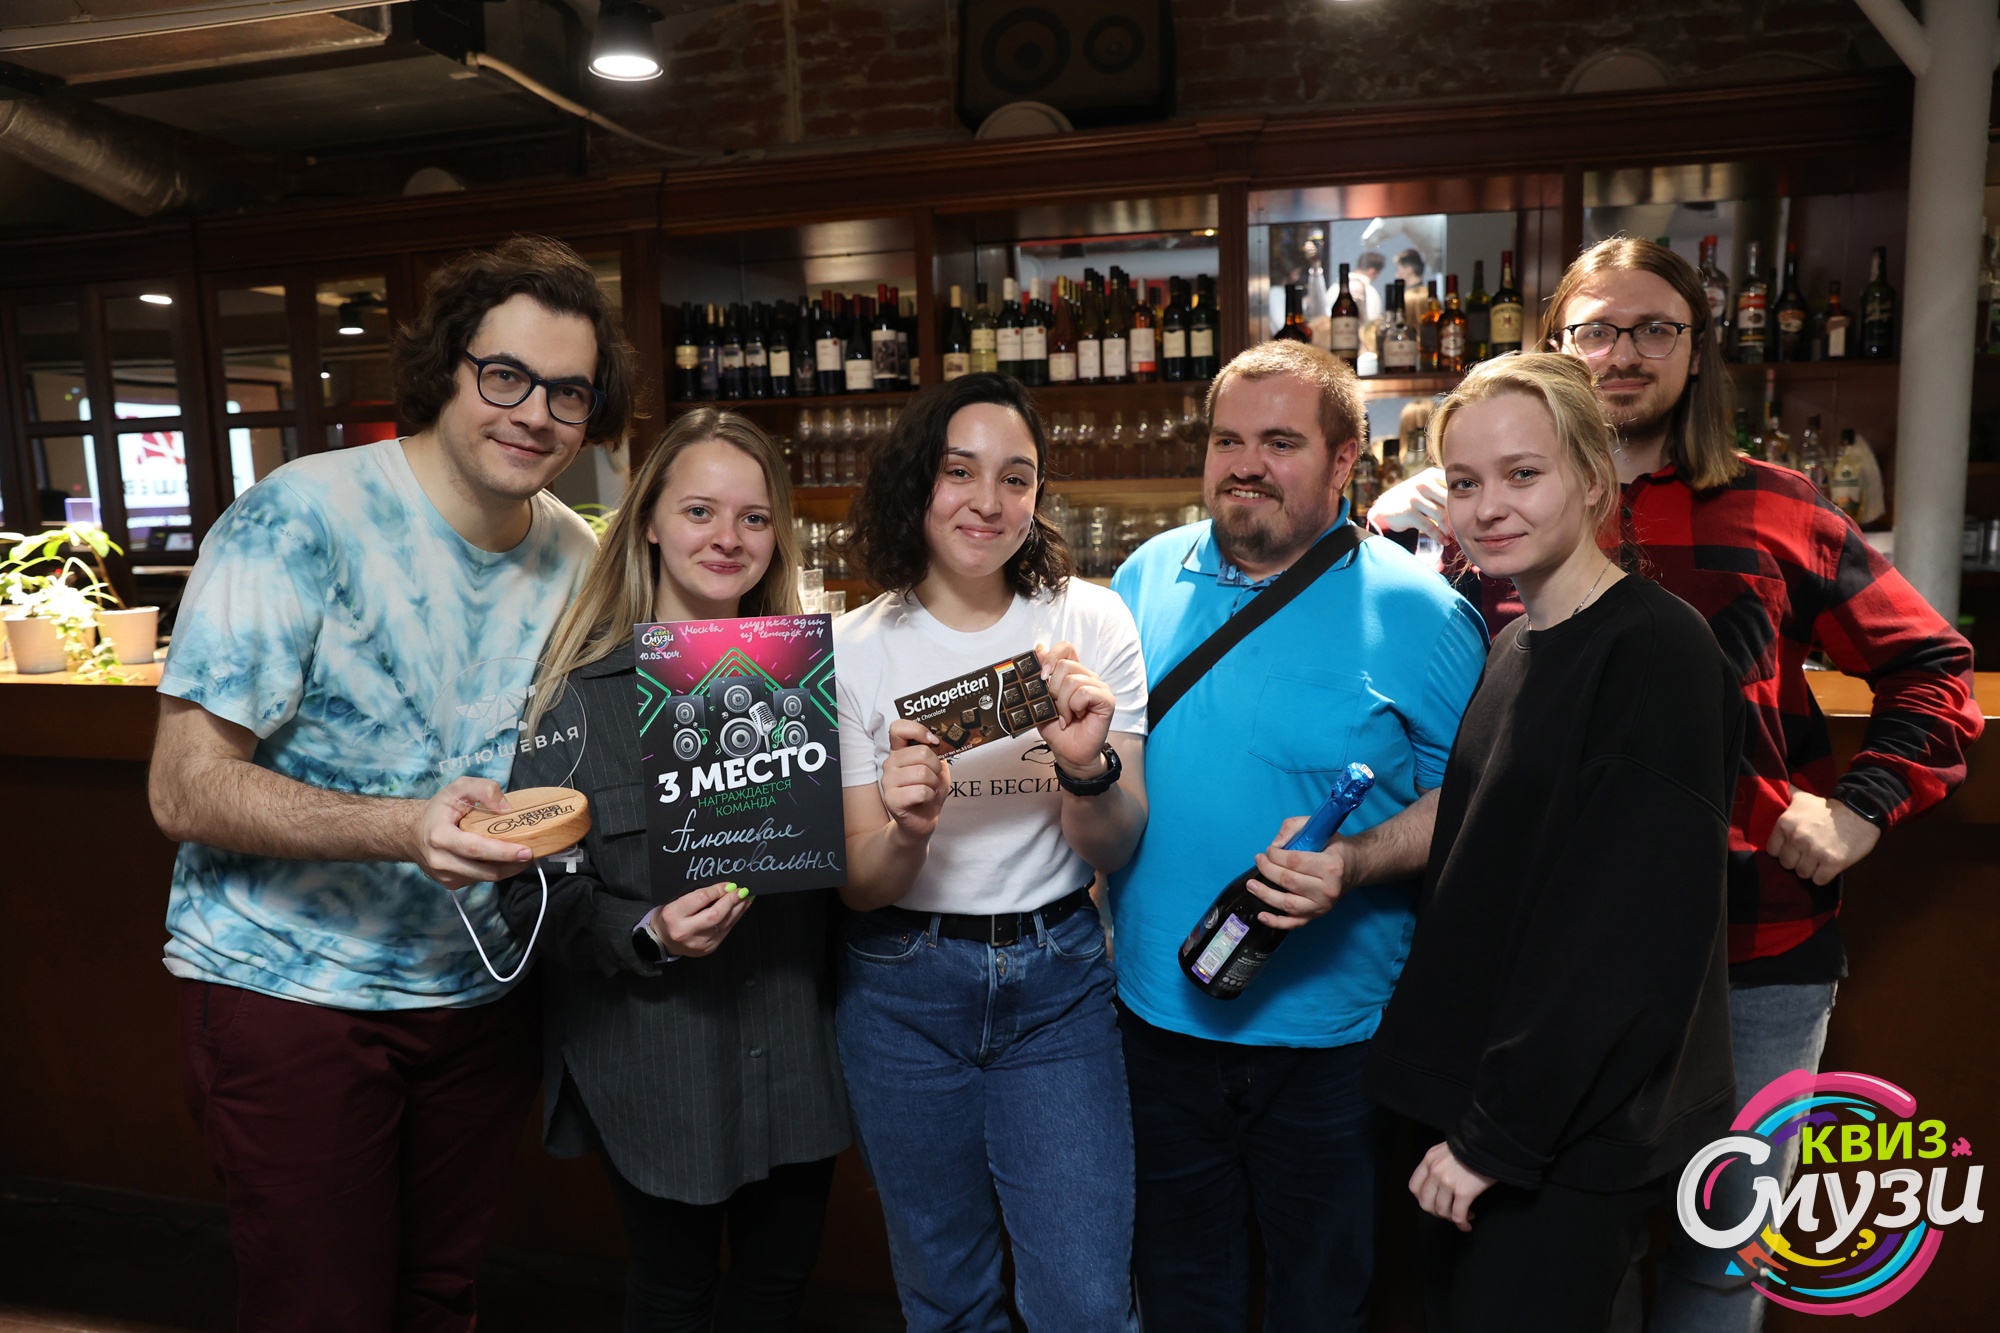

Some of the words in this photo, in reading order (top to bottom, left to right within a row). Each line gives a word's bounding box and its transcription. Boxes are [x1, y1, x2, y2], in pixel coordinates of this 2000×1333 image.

[681, 623, 724, 636] Москва
[793, 618, 826, 629] один
[740, 631, 753, 643] из
[903, 675, 990, 716] Schogetten
[921, 708, 947, 721] Chocolate
[439, 726, 579, 773] ПЛЮШЕВАЯ
[658, 771, 681, 804] 3
[690, 741, 827, 798] МЕСТО
[698, 779, 792, 809] НАГРАЖДАЕТСЯ
[948, 780, 982, 798] ЖЕ
[715, 796, 777, 817] КОМАНДА
[663, 808, 808, 853] Плюшевая
